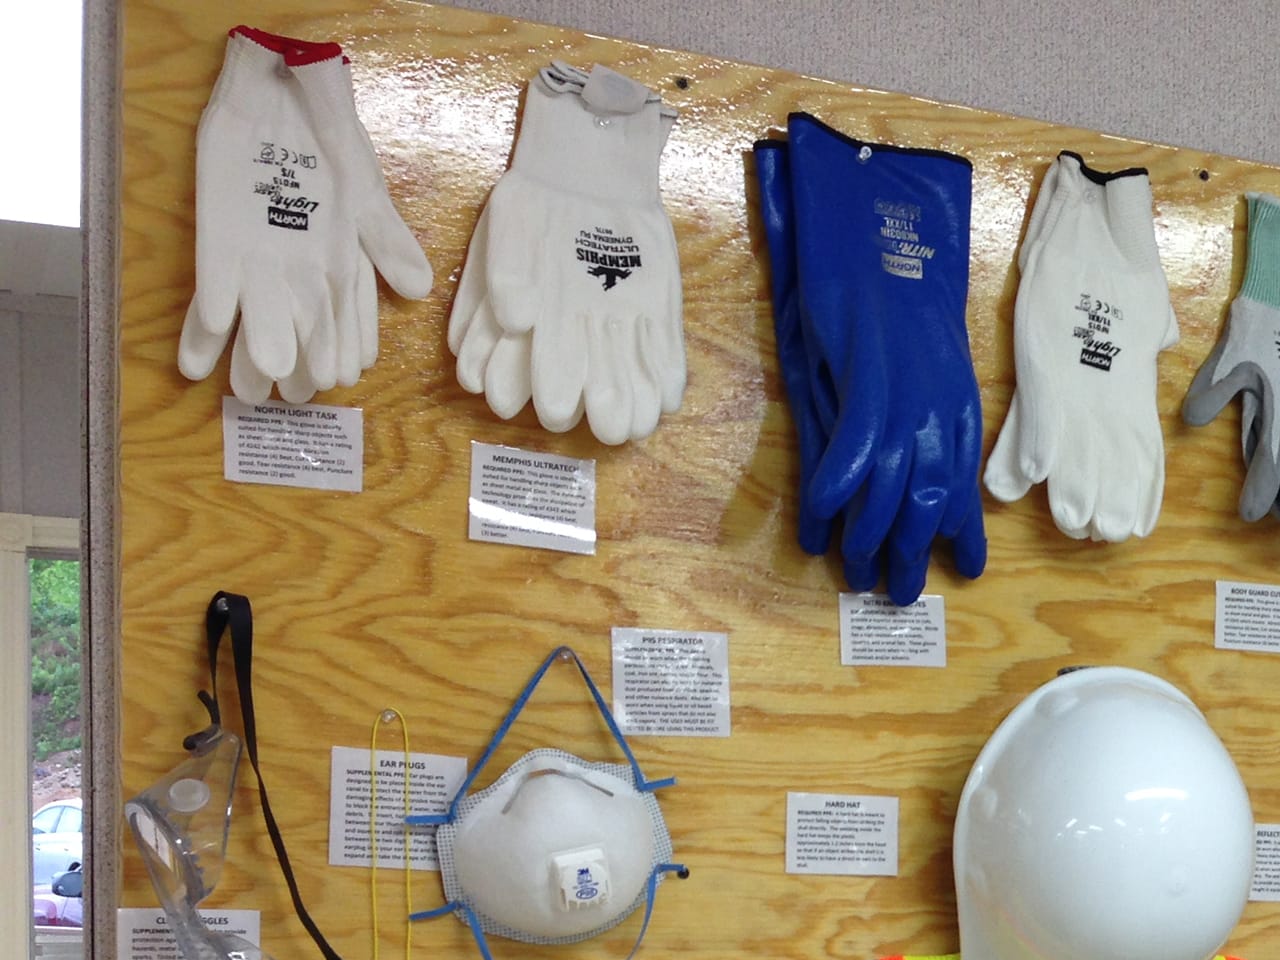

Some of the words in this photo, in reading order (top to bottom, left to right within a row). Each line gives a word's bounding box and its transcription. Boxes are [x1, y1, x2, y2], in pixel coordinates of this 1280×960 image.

[275, 197, 319, 212] Light
[270, 211, 306, 225] NORTH
[576, 238, 639, 252] ULTRATECH
[576, 248, 641, 267] MEMPHIS
[883, 259, 920, 272] NORTH
[1081, 353, 1110, 366] NORTH
[254, 406, 285, 415] NORTH
[288, 408, 312, 418] LIGHT
[316, 411, 338, 420] TASK
[492, 455, 531, 467] MEMPHIS
[533, 460, 580, 473] ULTRATECH
[1248, 589, 1269, 597] GUARD
[380, 760, 396, 768] EAR
[201, 917, 229, 925] GGLES
